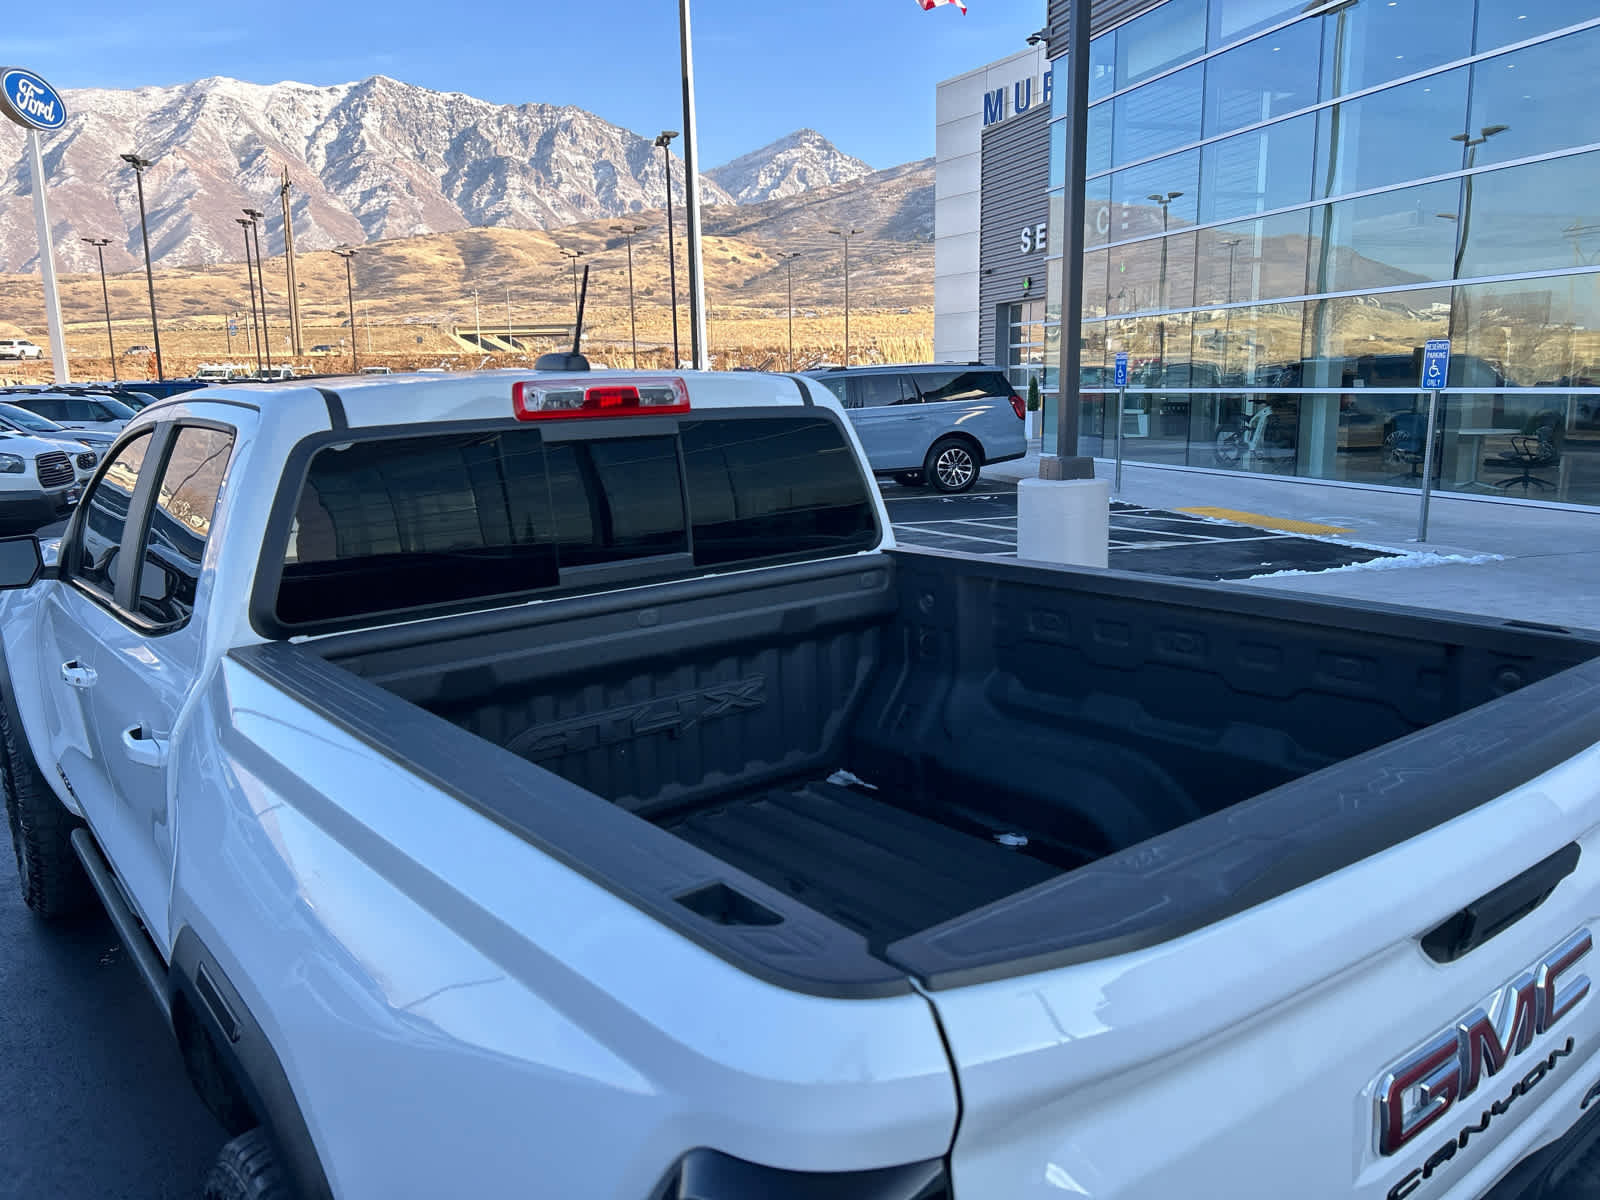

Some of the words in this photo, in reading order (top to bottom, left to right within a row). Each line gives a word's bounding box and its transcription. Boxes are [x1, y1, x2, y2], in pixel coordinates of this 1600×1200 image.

[16, 79, 55, 121] Ford
[1426, 351, 1447, 359] PARKING
[1374, 928, 1593, 1156] GMC
[1387, 1036, 1575, 1200] CANYON
